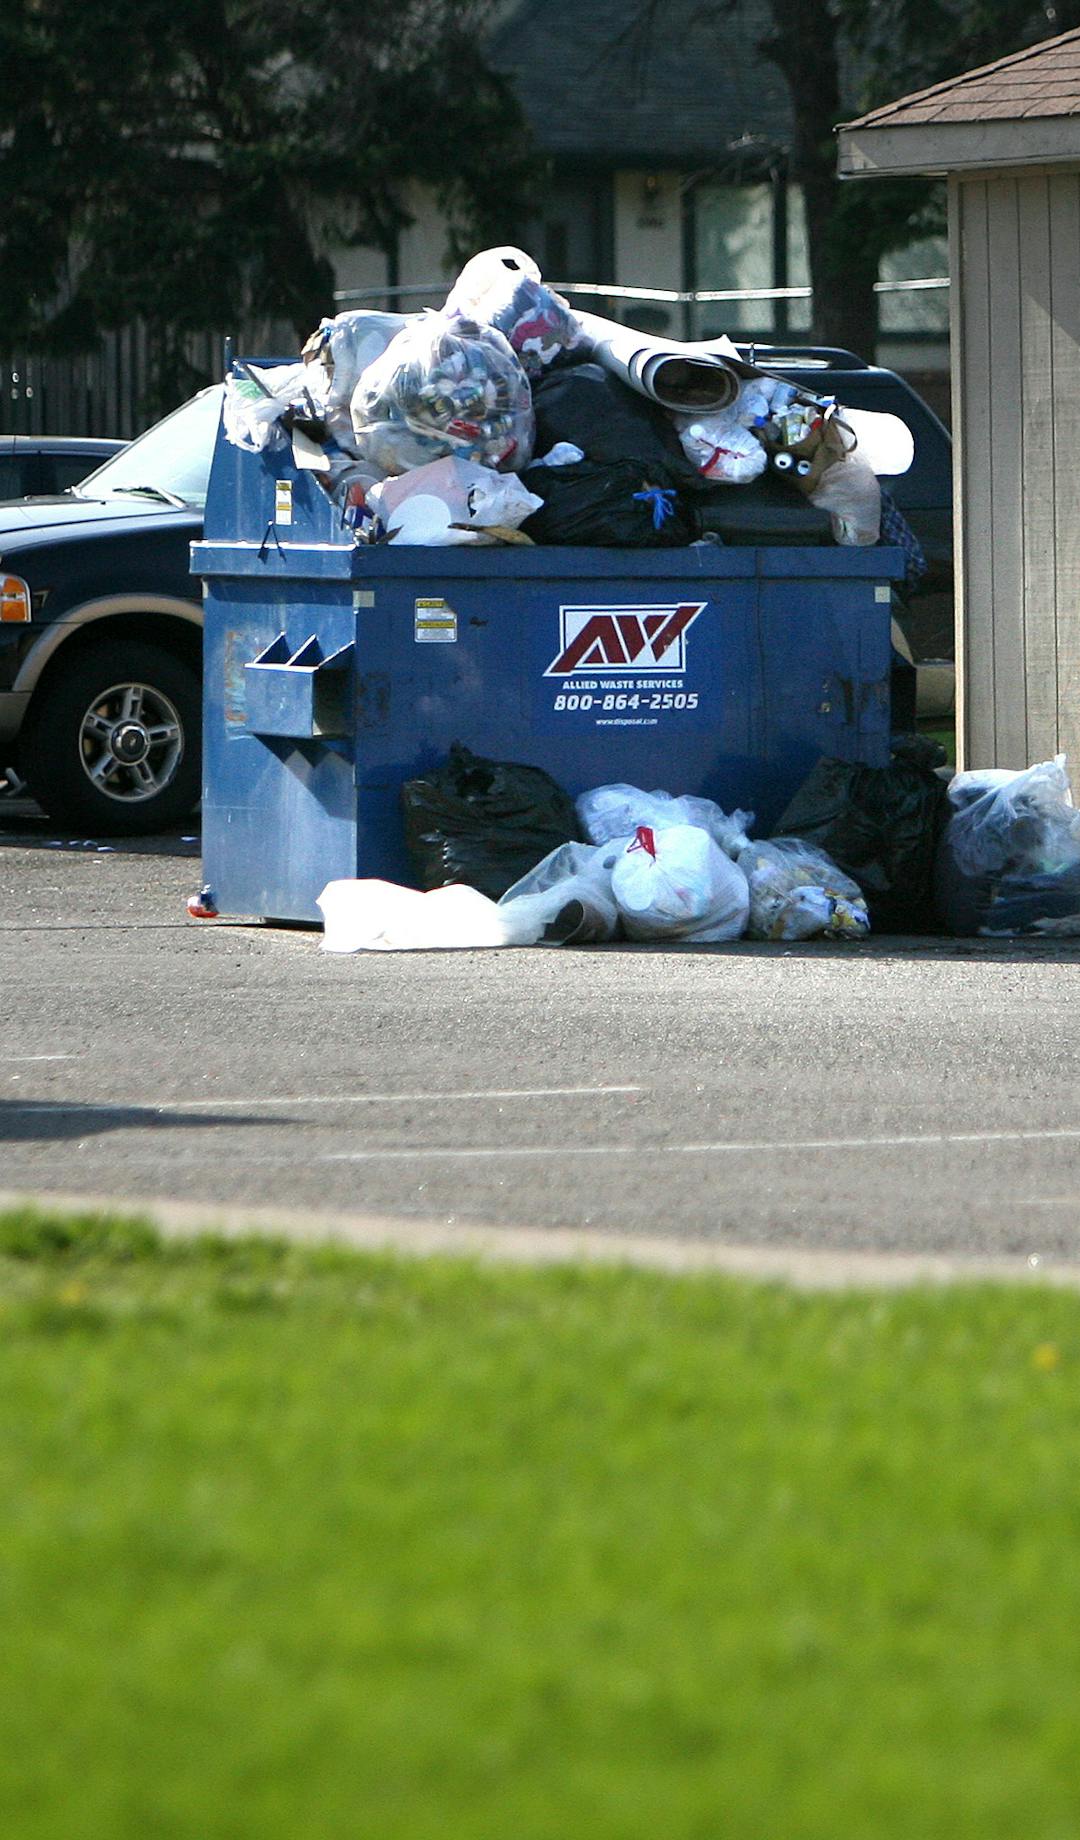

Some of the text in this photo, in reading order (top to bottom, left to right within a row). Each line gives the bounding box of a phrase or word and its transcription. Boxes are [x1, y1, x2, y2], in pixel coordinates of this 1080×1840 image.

[546, 604, 705, 675] AW
[562, 679, 684, 690] ALLIED WASTE SERVICES
[553, 693, 699, 711] 800-864-2505
